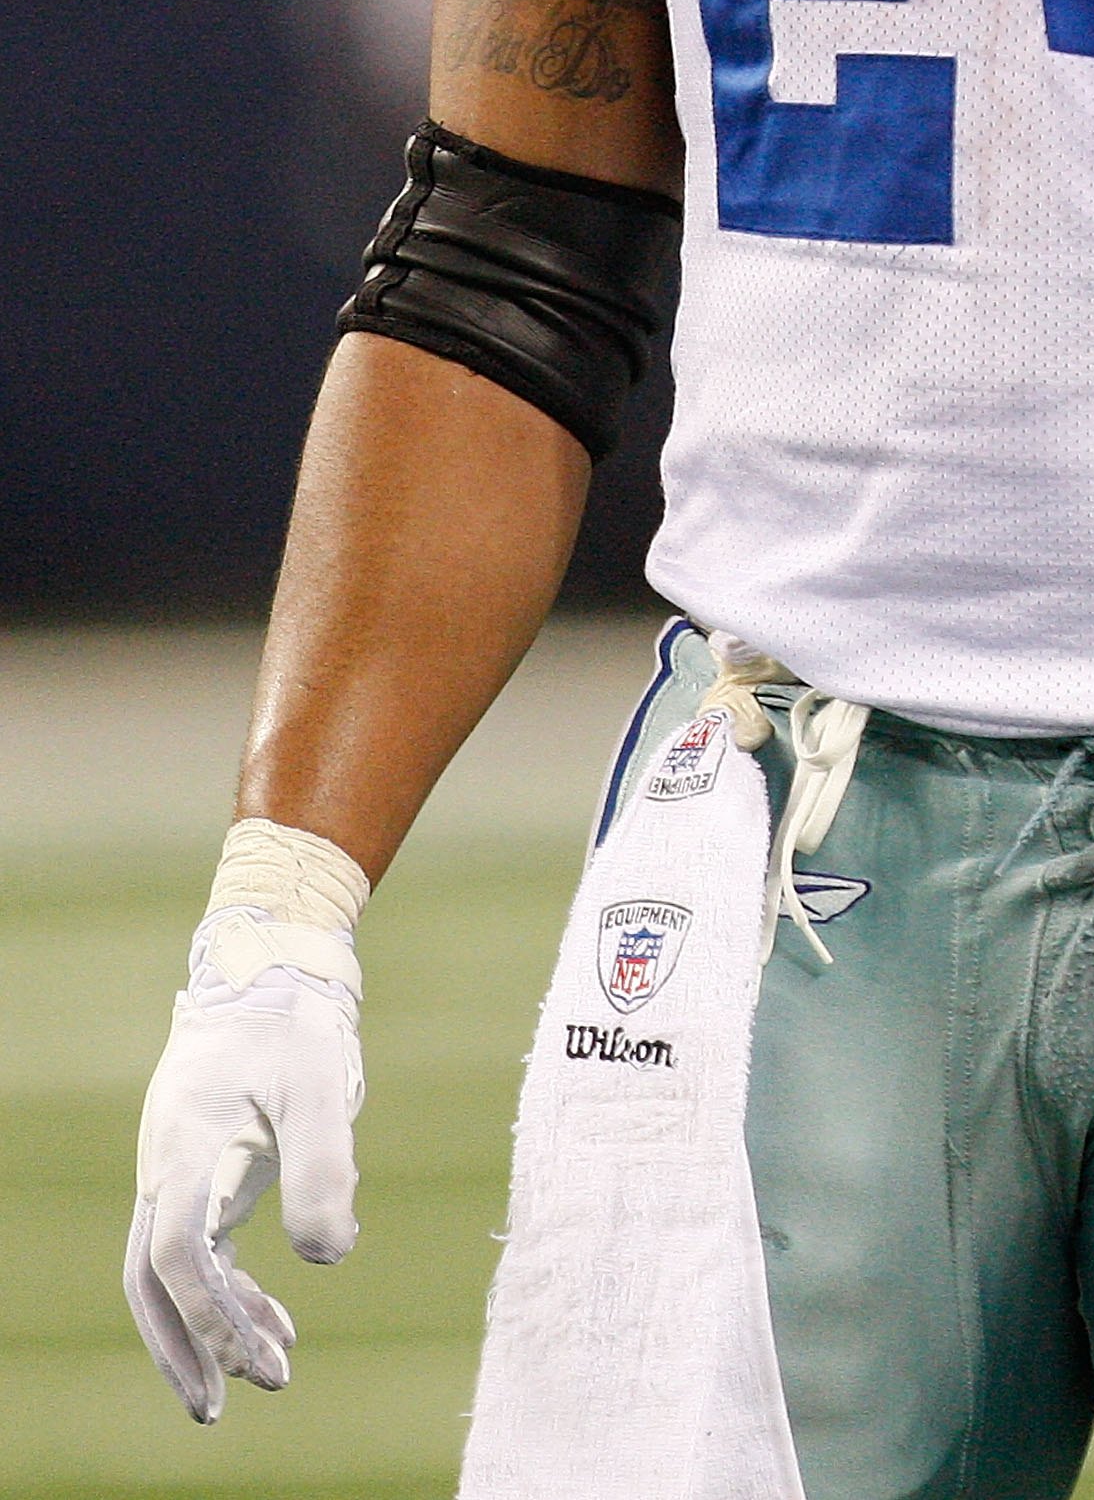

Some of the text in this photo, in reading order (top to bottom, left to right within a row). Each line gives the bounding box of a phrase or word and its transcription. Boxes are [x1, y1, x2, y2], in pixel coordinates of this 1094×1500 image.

[605, 906, 688, 932] EQUIPMENT
[611, 957, 651, 995] NFL
[566, 1024, 676, 1069] Wilson
